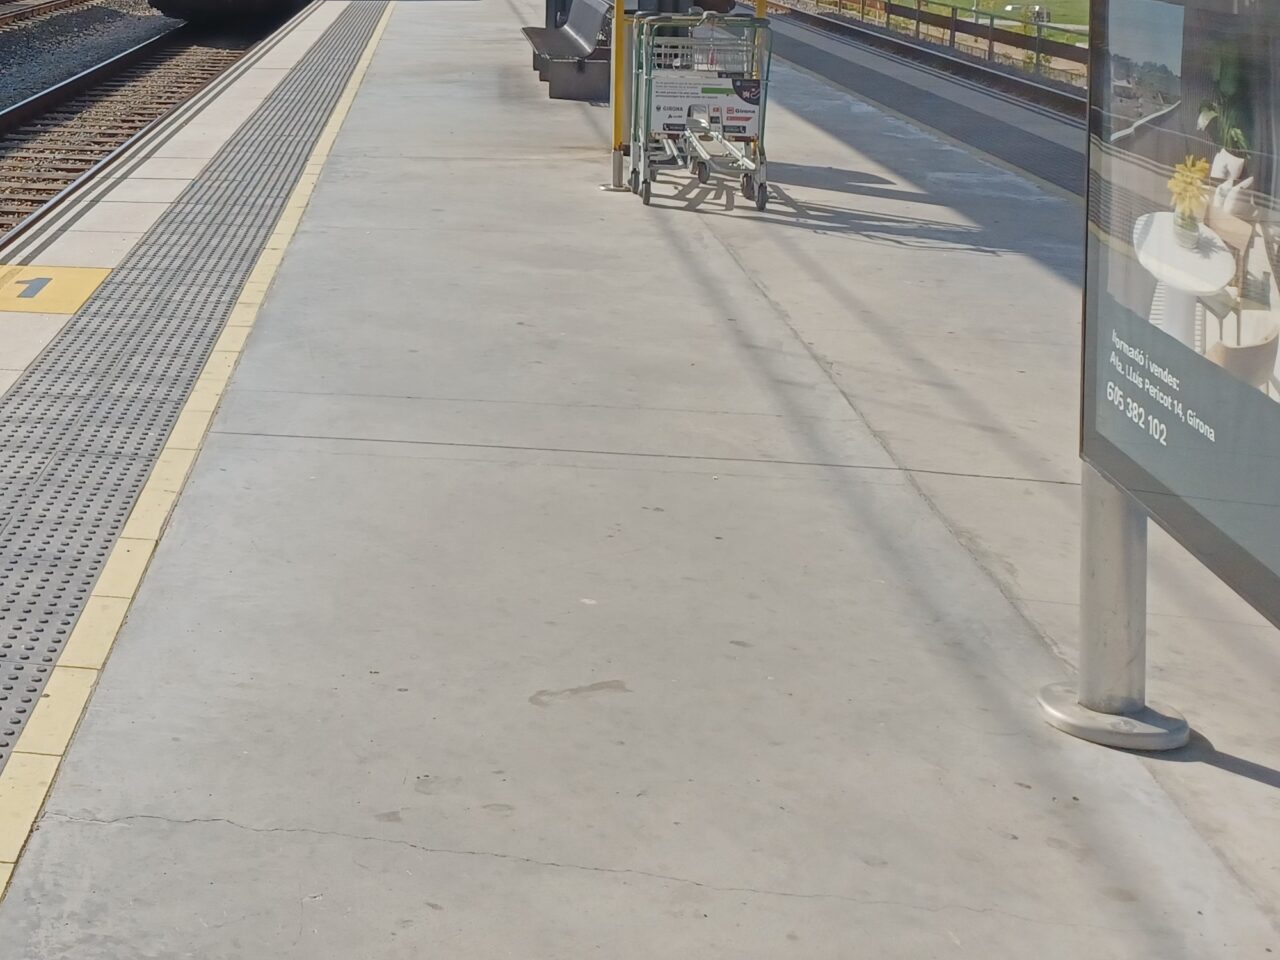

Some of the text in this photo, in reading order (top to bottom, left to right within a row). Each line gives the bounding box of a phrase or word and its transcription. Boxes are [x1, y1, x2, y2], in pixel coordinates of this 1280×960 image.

[15, 277, 53, 298] 1
[1126, 397, 1145, 429] 382
[1148, 414, 1167, 446] 102
[1186, 409, 1216, 443] Girona
